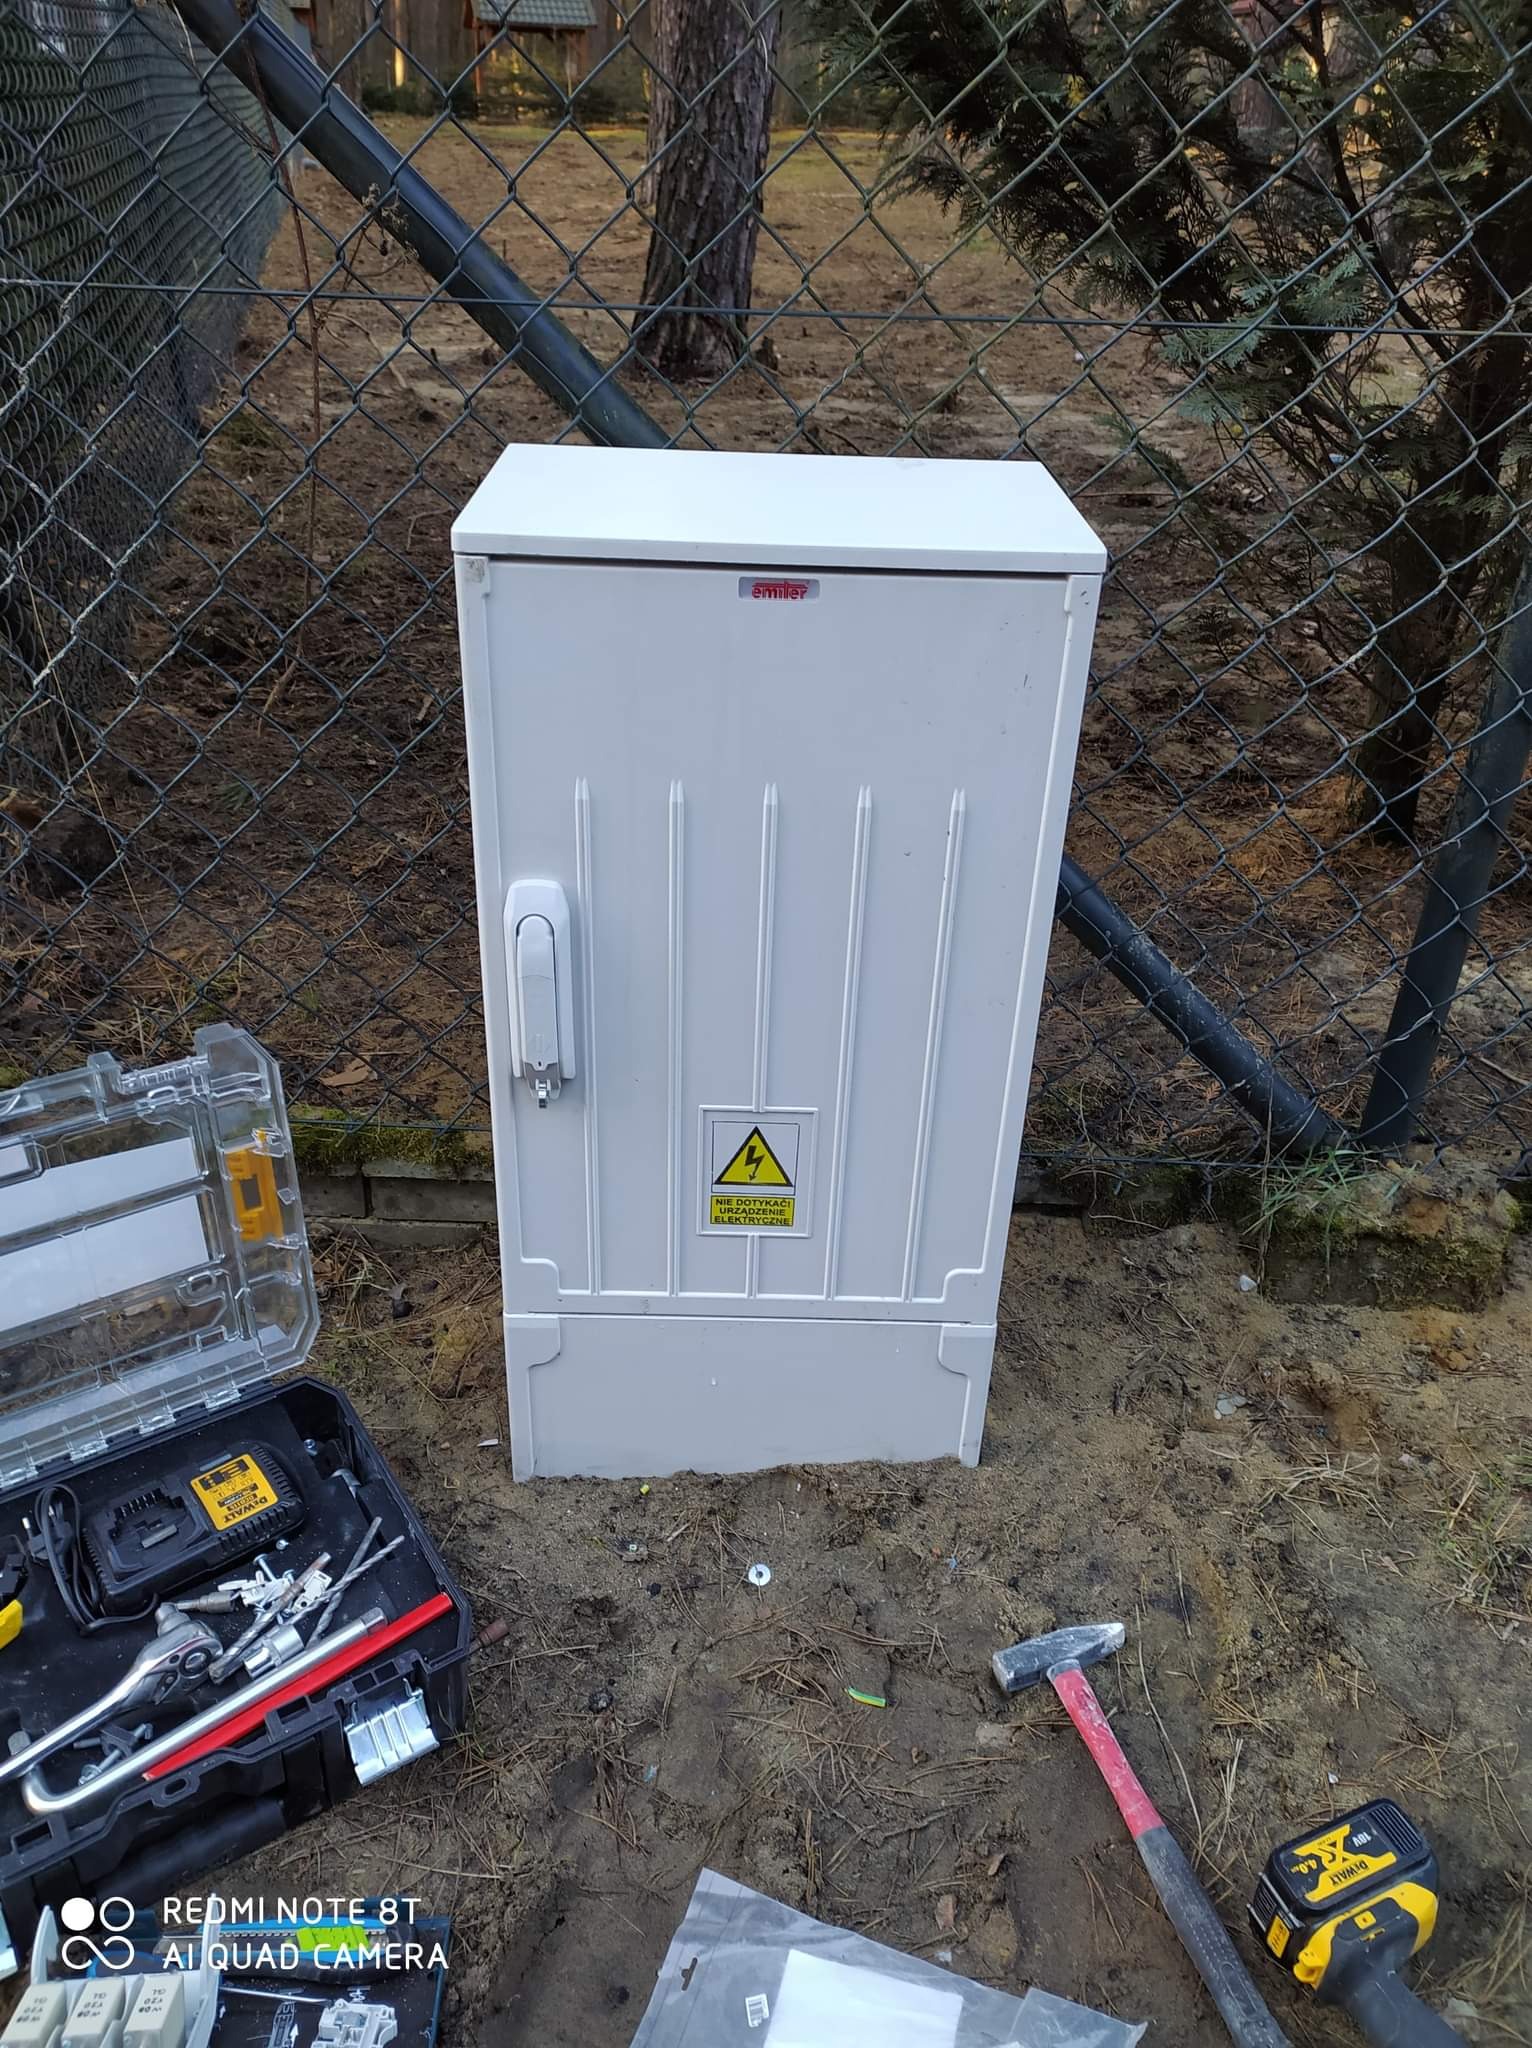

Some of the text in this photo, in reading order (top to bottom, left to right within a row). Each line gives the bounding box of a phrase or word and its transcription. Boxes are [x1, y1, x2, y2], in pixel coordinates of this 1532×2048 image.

[715, 1198, 791, 1208] NIE DOTYKAĆ!
[719, 1207, 785, 1217] URZĄDZENIE
[714, 1216, 791, 1225] ELEKTRYCZNE
